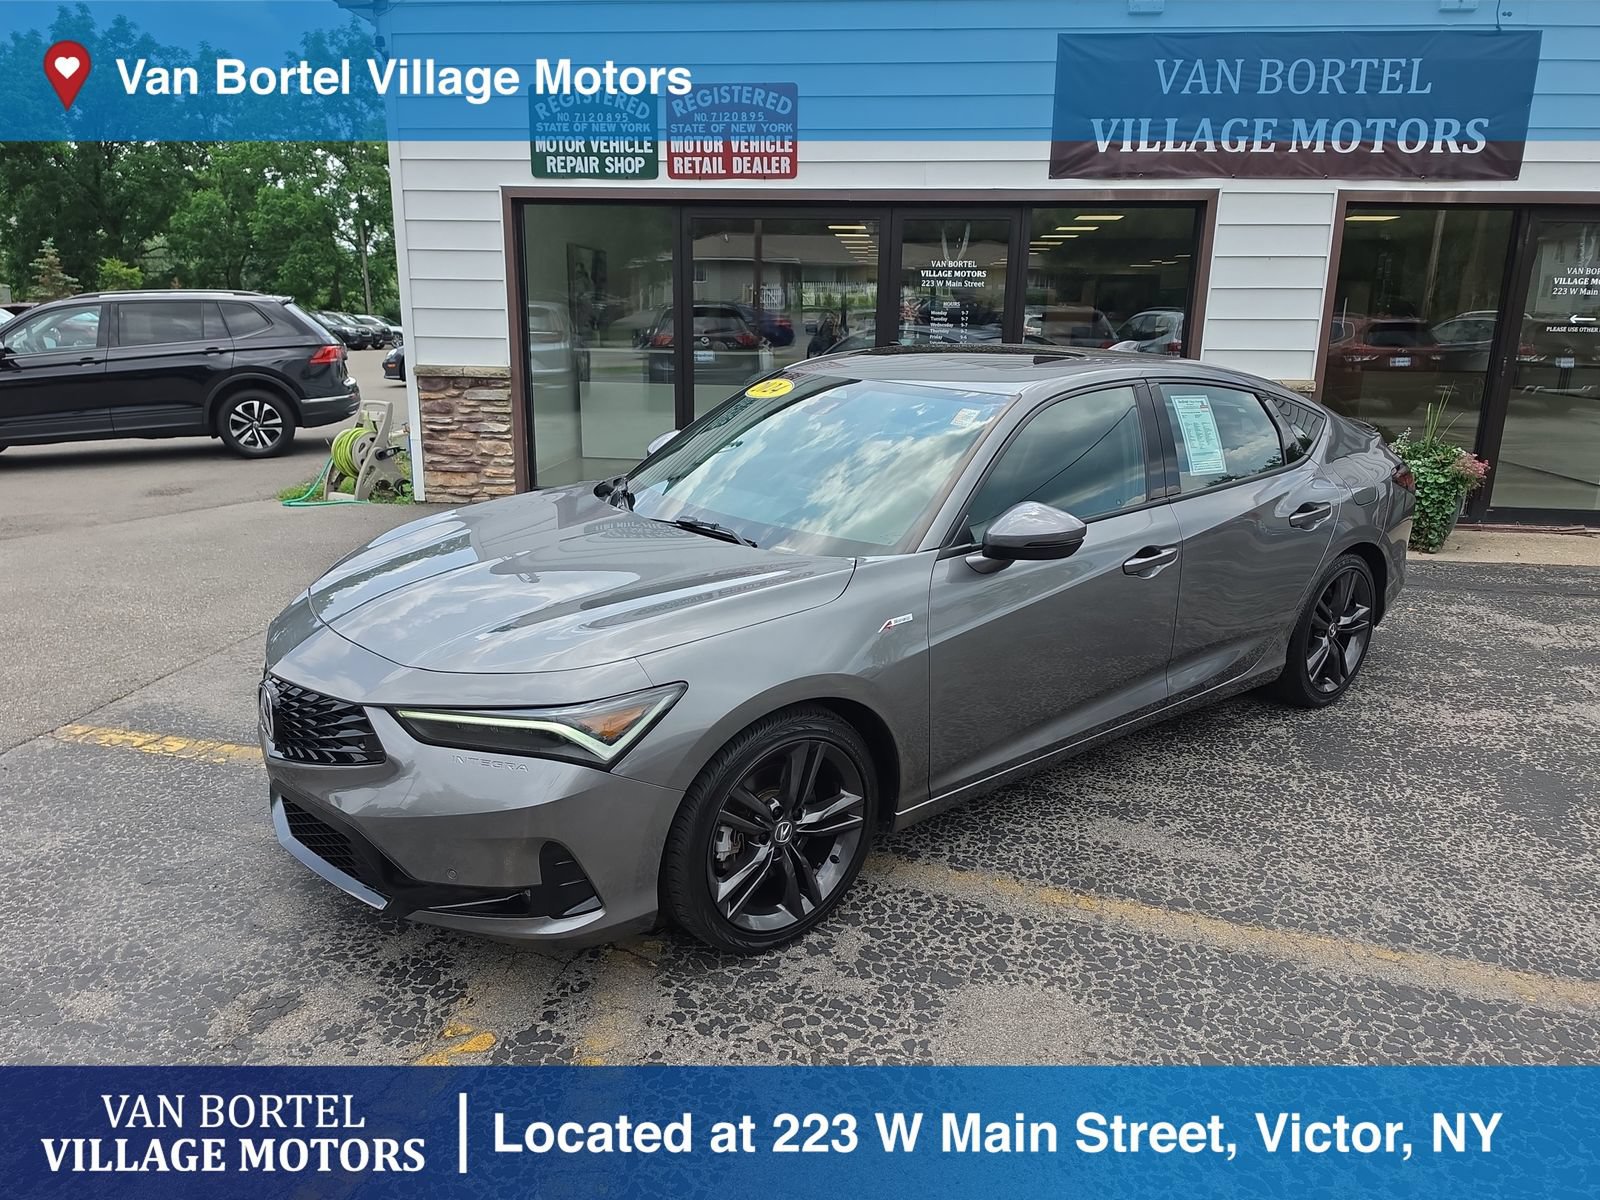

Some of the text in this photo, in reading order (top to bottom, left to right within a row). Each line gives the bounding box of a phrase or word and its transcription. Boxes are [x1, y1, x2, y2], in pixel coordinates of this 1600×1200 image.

[1155, 57, 1433, 95] VAN BORTEL
[534, 87, 651, 120] REGISTERED
[671, 85, 793, 118] REGISTERED
[574, 112, 629, 122] 7120895
[711, 111, 765, 122] 7120895
[536, 122, 651, 133] STATE OF NEW YORK
[670, 123, 793, 133] STATE OF NEW YORK
[1090, 117, 1490, 154] VILLAGE MOTORS
[535, 135, 654, 154] MOTOR VEHICLE
[670, 136, 794, 154] MOTOR VEHICLE
[546, 156, 646, 175] REPAIR SHOP
[673, 156, 791, 175] RETAIL DEALER
[931, 260, 977, 268] VAN BORTEL
[920, 270, 987, 278] VILLAGE MOTORS
[1567, 267, 1584, 275] VAN
[945, 280, 963, 288] Main
[963, 280, 985, 288] Street
[1554, 277, 1590, 285] VILLAGE
[1552, 287, 1599, 296] 223 W Main
[451, 754, 529, 774] INTEGRA
